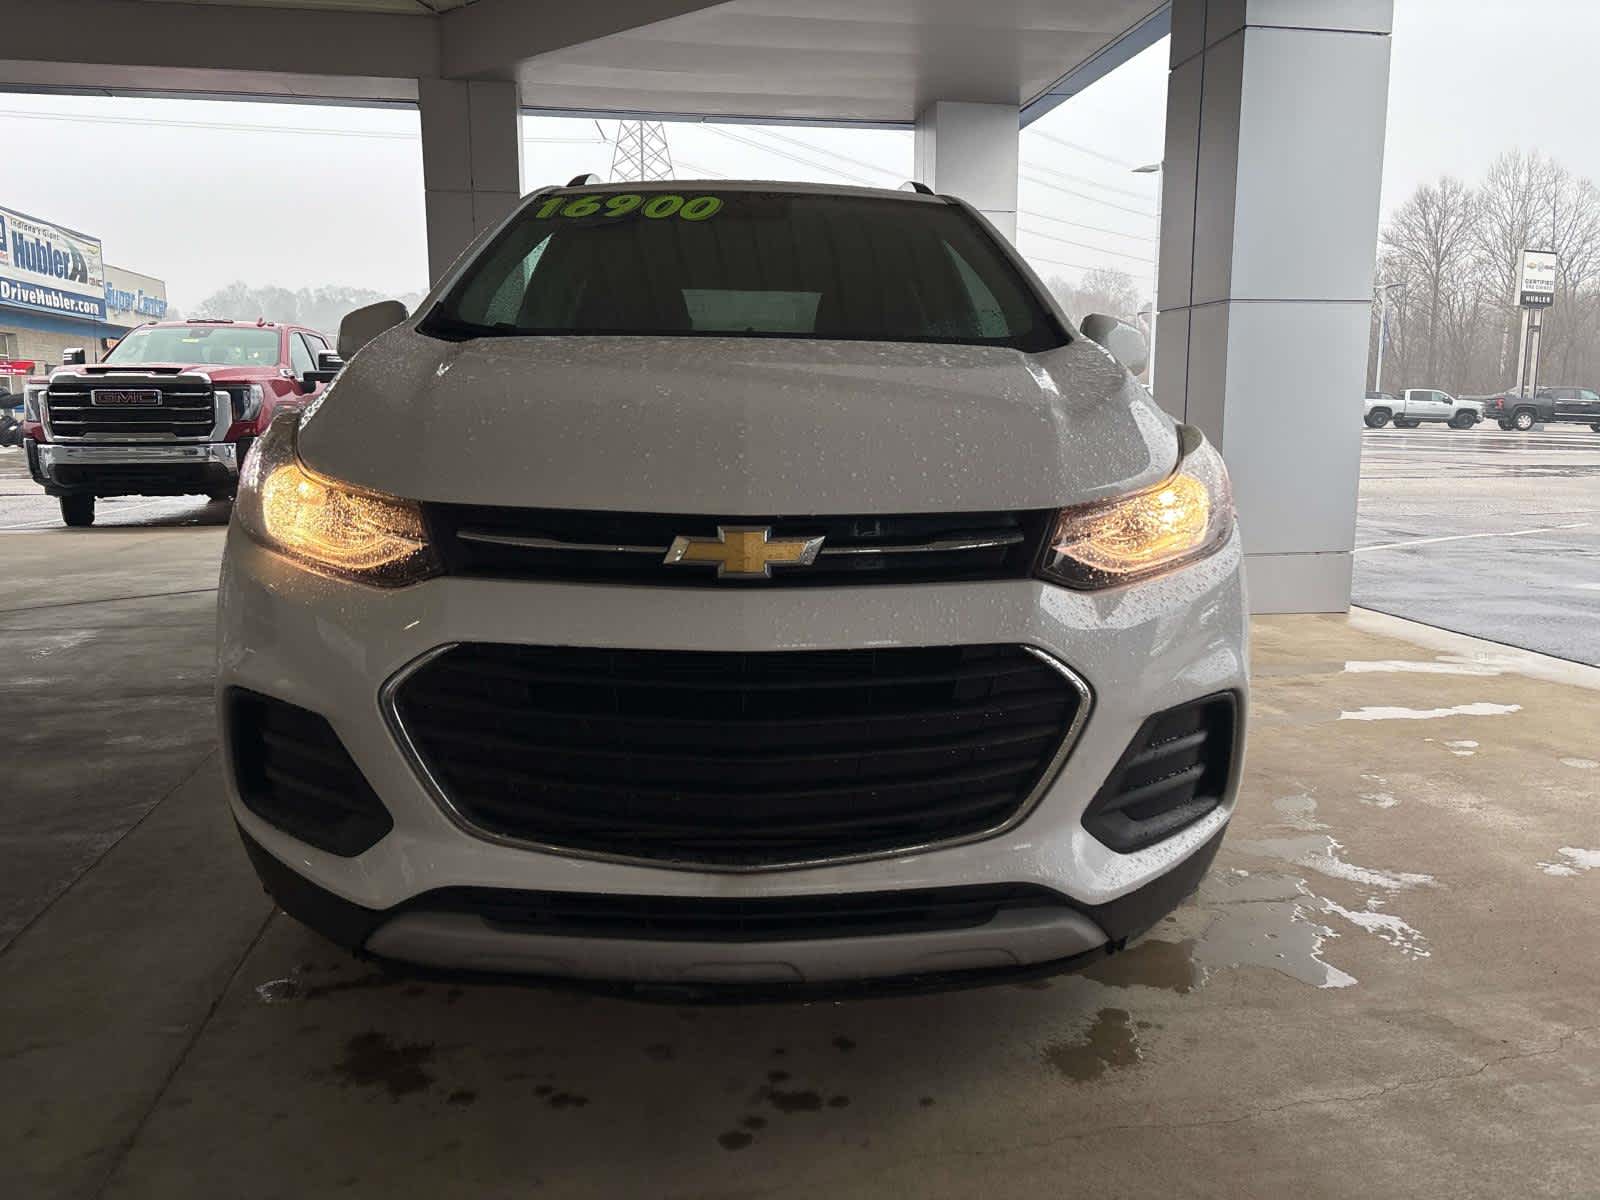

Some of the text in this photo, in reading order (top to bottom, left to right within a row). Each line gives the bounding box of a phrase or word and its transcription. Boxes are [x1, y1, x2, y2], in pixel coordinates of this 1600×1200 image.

[535, 194, 722, 221] 16900
[12, 230, 70, 280] Hubler
[0, 281, 99, 314] DriveHubler.com
[96, 391, 156, 403] GMC
